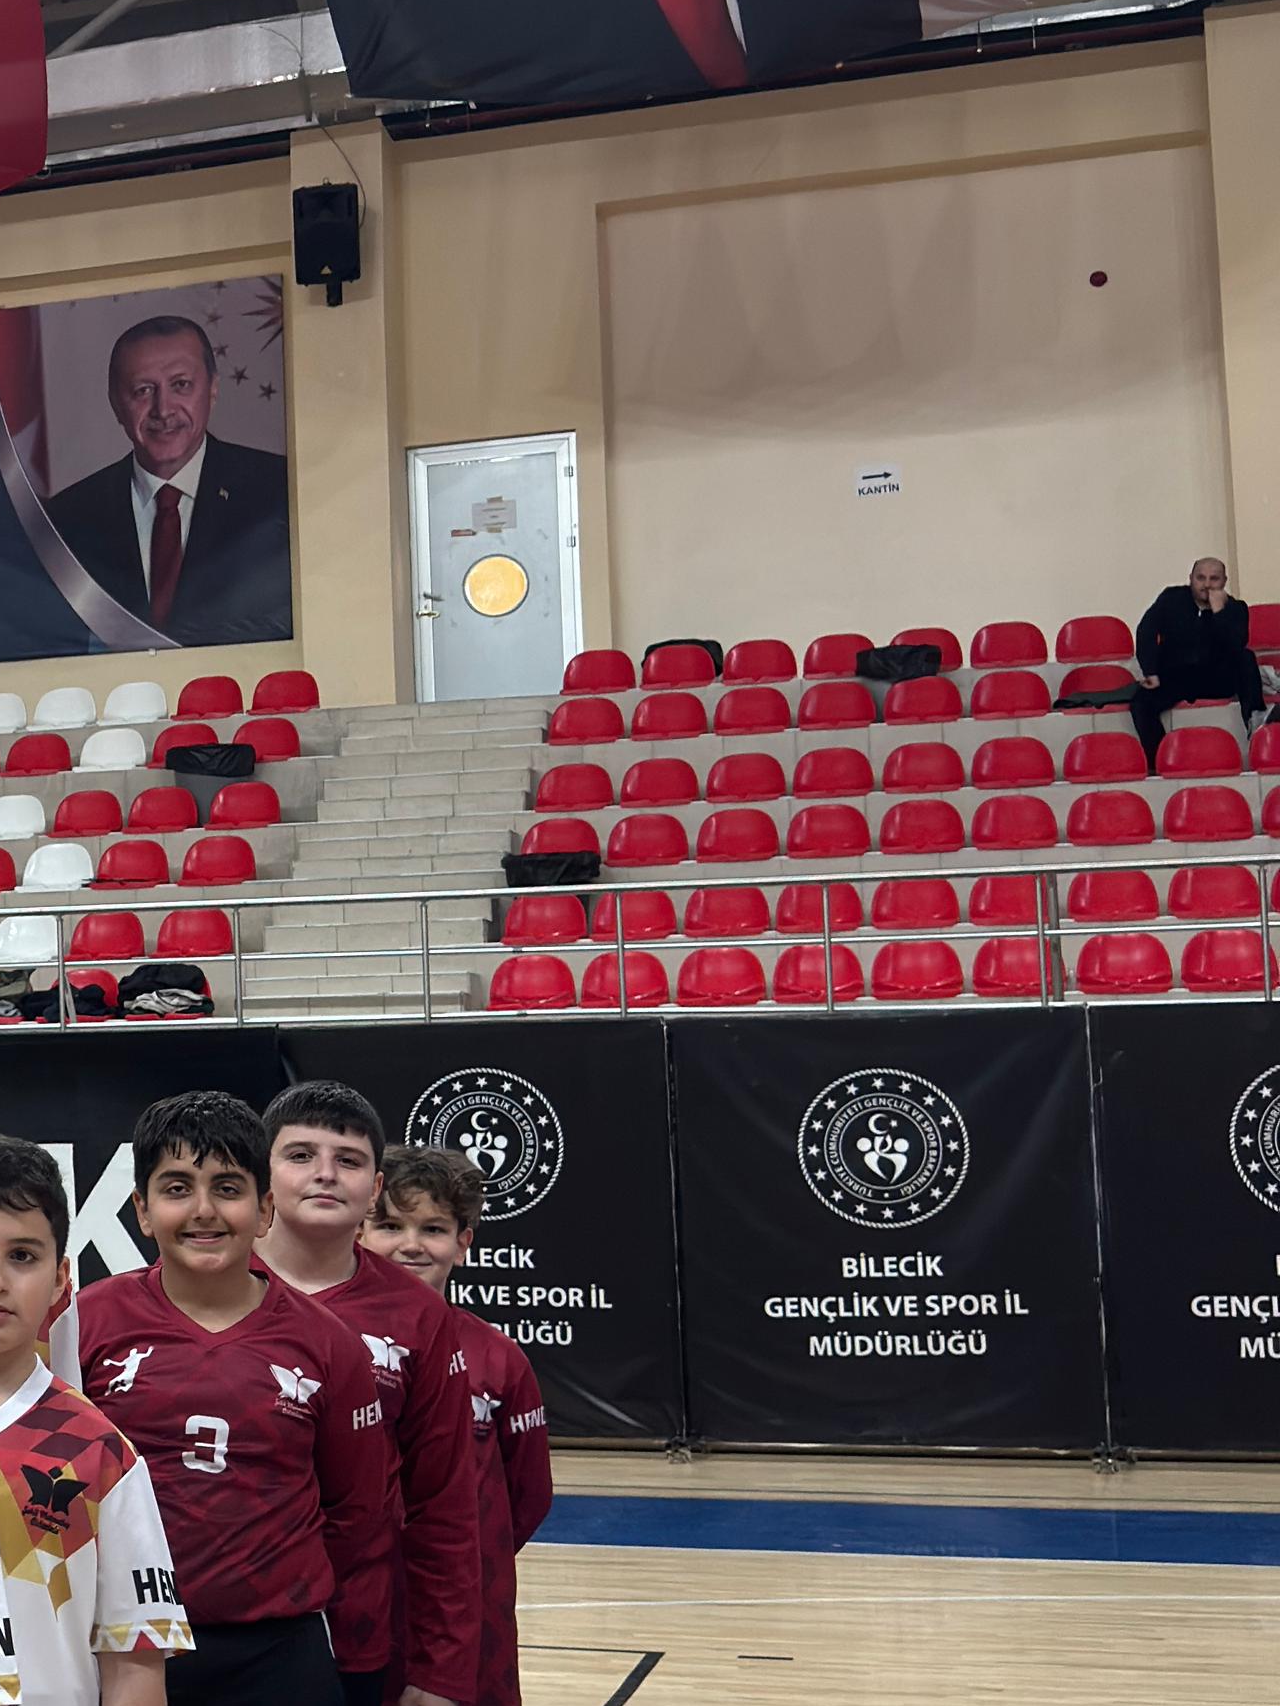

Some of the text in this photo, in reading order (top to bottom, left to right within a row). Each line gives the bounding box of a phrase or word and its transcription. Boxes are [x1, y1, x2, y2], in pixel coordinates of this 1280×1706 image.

[858, 482, 900, 496] KANTİN
[465, 1244, 535, 1269] LECİK
[841, 1251, 943, 1278] BİLECİK
[478, 1285, 511, 1306] VE
[516, 1286, 584, 1308] SPOR
[591, 1283, 613, 1309] İL
[764, 1289, 1029, 1323] GENÇLİK VE SPOR İL
[1190, 1295, 1280, 1323] GENÇL
[809, 1329, 988, 1356] MÜDÜRLÜĞÜ
[181, 1414, 230, 1475] 3
